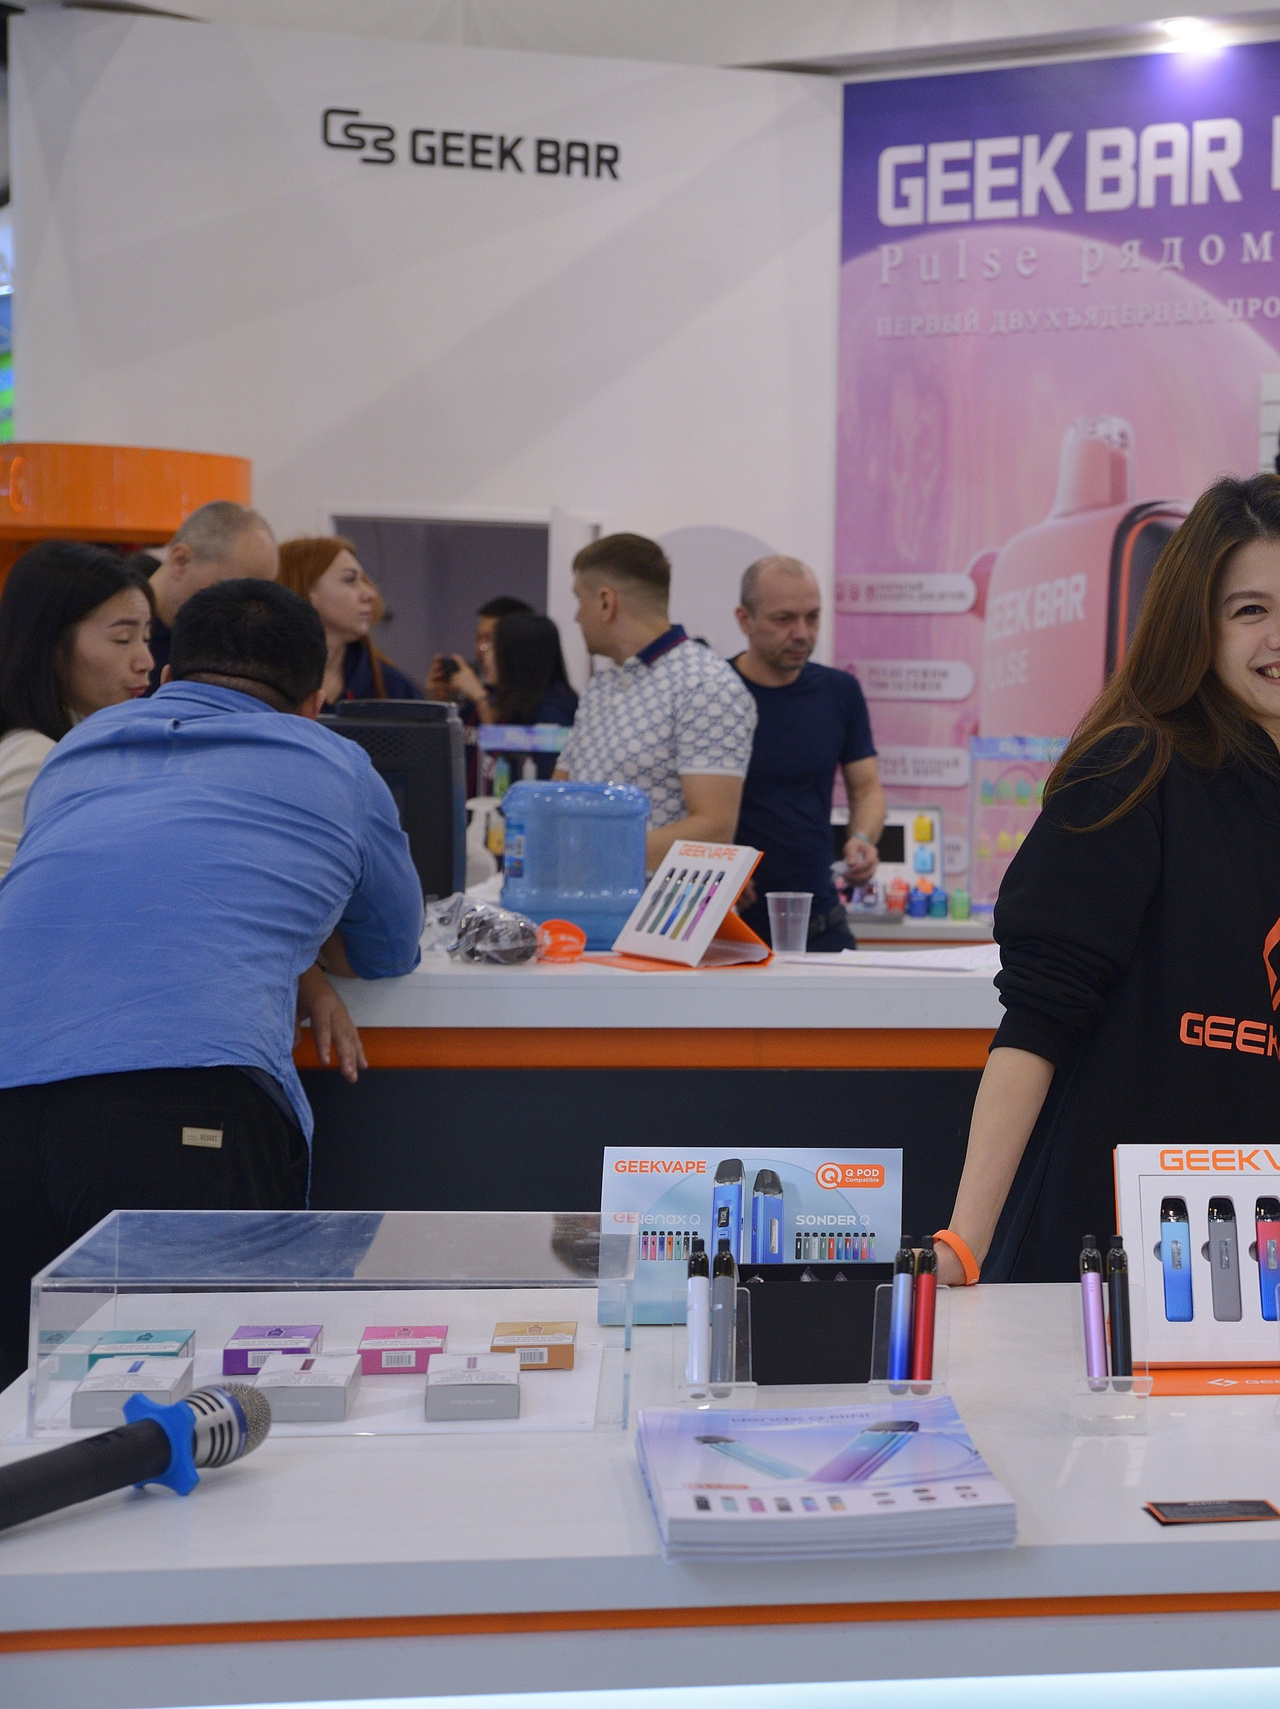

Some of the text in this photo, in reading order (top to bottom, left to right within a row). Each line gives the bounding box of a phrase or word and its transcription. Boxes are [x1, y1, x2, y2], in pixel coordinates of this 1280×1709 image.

[410, 129, 524, 173] GEEK
[535, 138, 619, 180] BAR
[876, 131, 1074, 228] GEEK
[1085, 116, 1244, 213] BAR
[878, 237, 1039, 286] Pulse
[1078, 230, 1275, 286] рядом
[875, 307, 981, 339] ПЕРВЫЙ
[614, 1160, 707, 1174] GEEKVAPE
[845, 1169, 880, 1178] Q POD
[845, 1176, 880, 1184] Compatible
[689, 1214, 701, 1226] Q
[795, 1215, 870, 1226] SONDER Q
